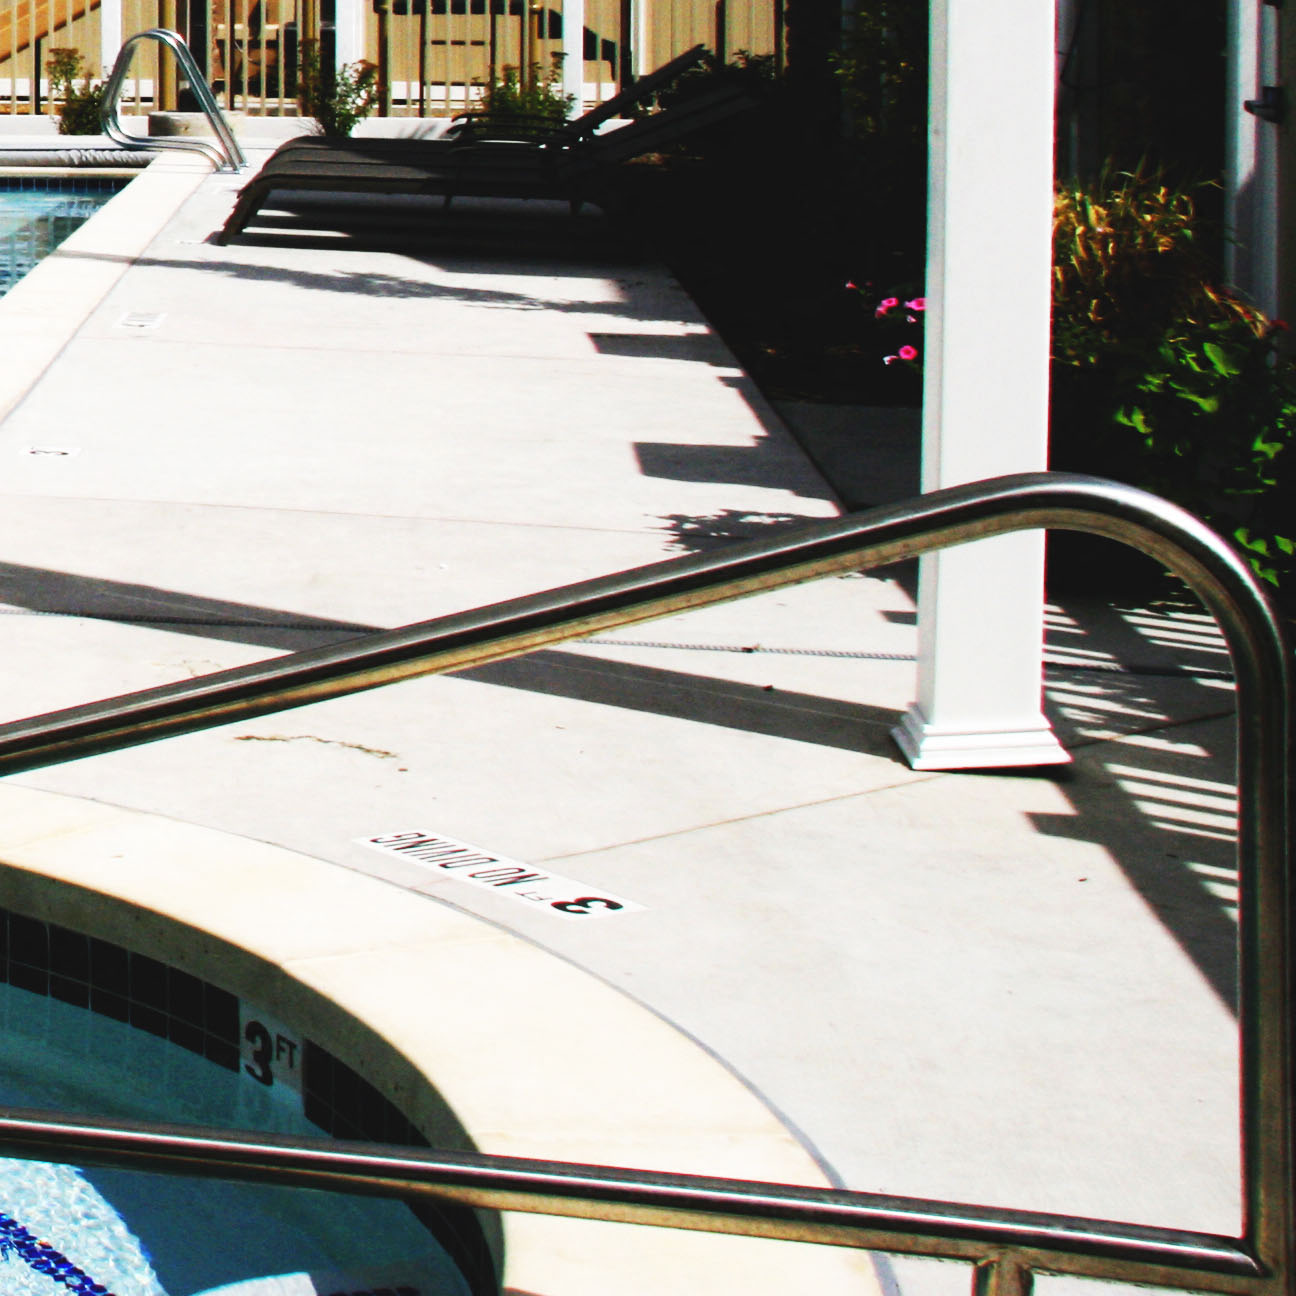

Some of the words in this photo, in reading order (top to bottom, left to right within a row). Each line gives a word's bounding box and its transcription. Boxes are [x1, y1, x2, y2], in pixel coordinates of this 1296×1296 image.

[370, 832, 499, 869] DIVING
[468, 867, 550, 887] NO
[550, 896, 624, 915] 3
[245, 1020, 274, 1086] 3
[276, 1033, 297, 1069] FT
